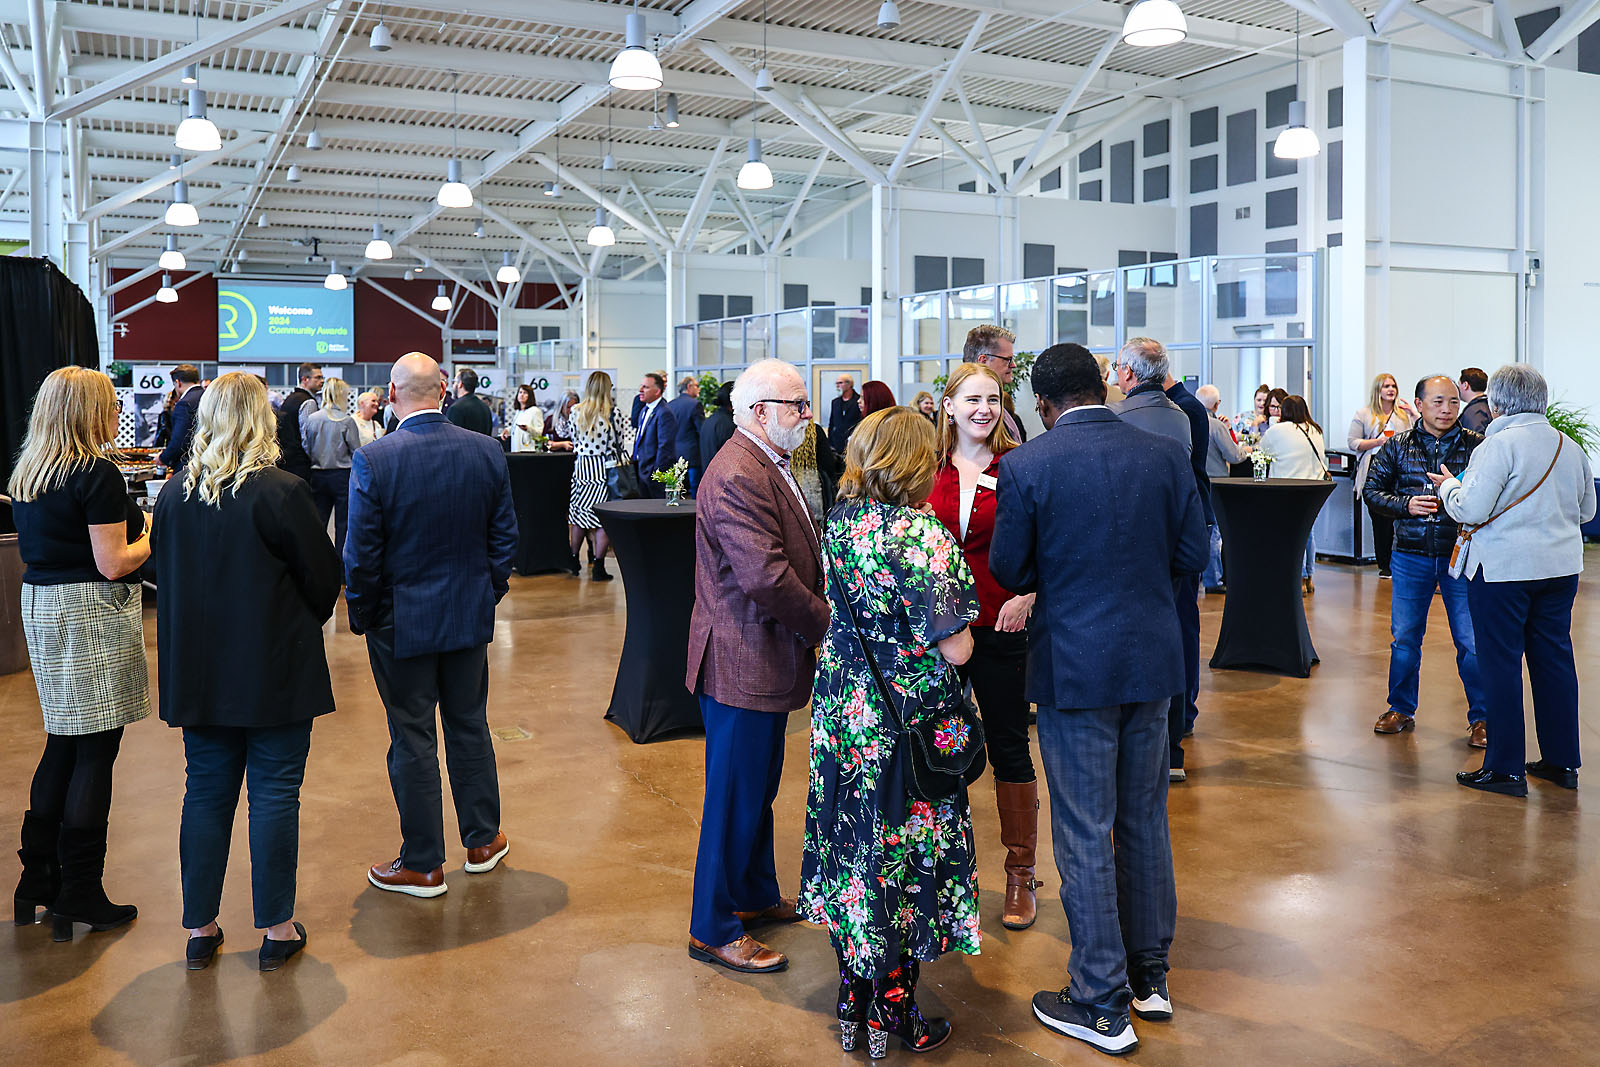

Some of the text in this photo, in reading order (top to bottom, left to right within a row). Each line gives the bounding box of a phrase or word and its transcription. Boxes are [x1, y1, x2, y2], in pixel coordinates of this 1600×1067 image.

[268, 305, 313, 316] Welcome
[268, 316, 290, 325] 2024
[268, 325, 348, 337] Community Awards
[140, 375, 164, 389] 60
[530, 378, 549, 390] 60
